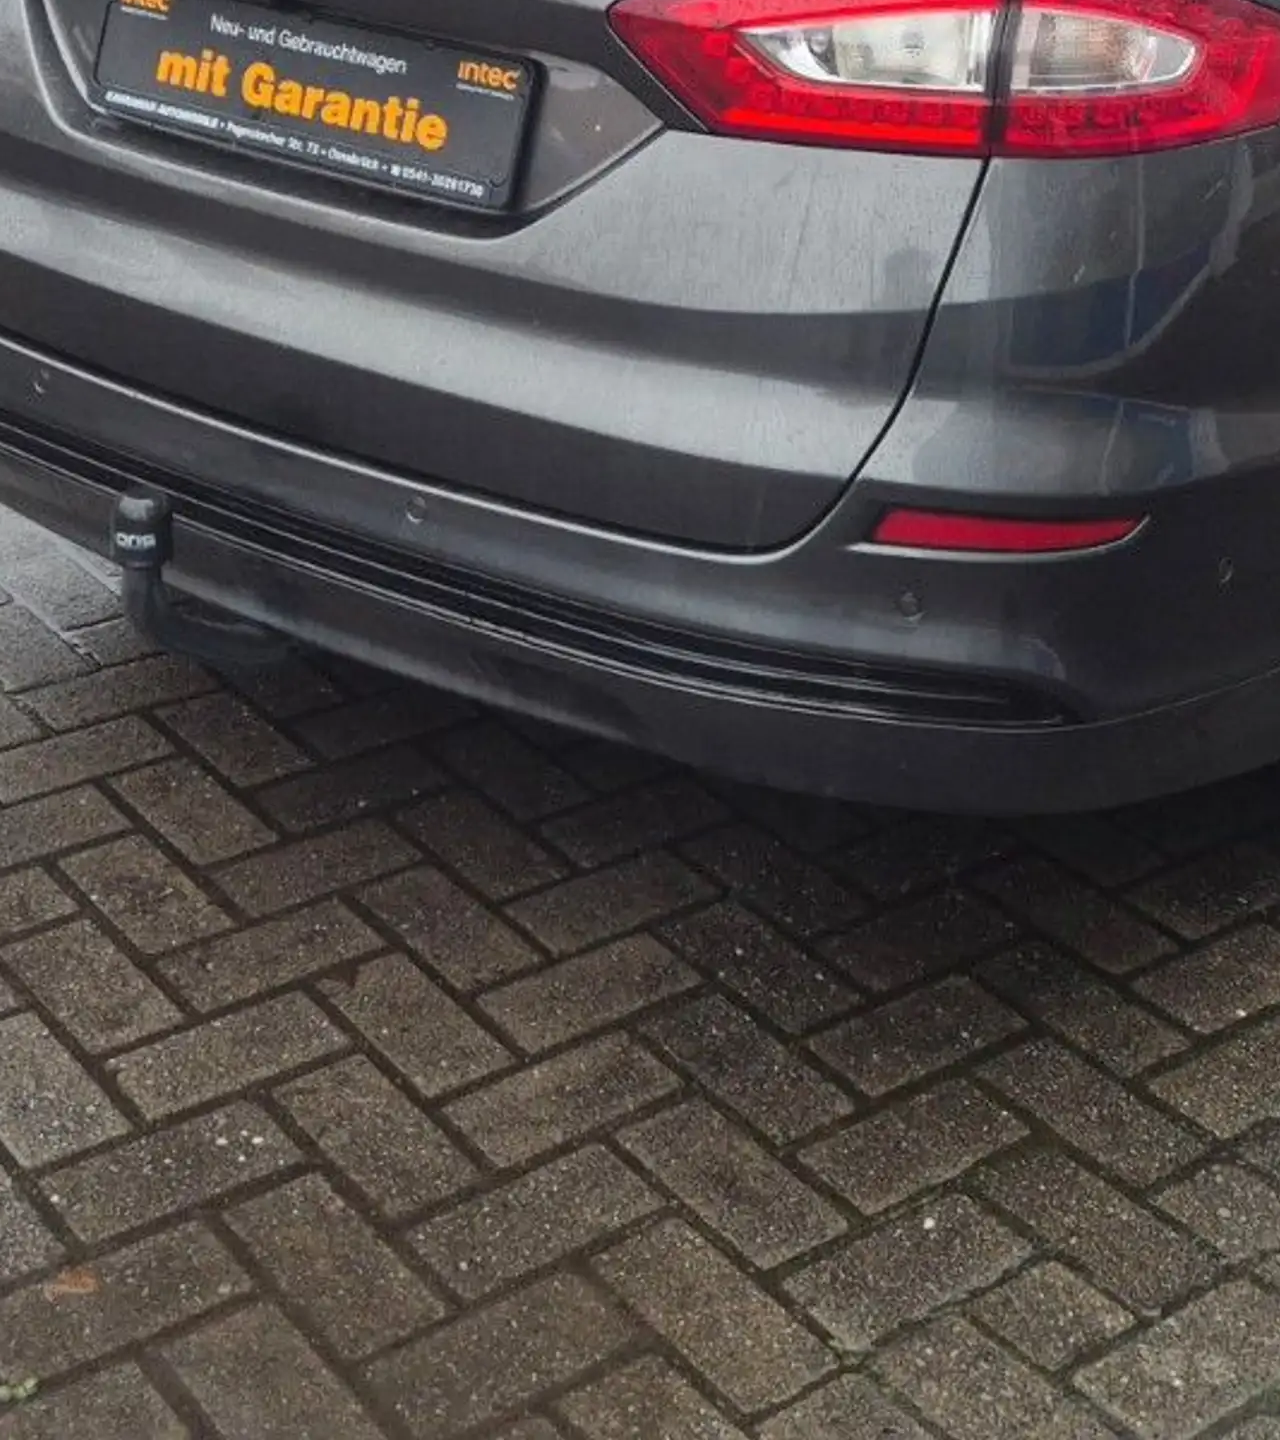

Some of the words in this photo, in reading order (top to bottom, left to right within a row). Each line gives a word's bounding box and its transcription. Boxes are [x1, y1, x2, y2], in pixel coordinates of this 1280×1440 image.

[210, 13, 245, 37] Neu-
[248, 24, 275, 45] und
[278, 28, 408, 75] Gebrauchtwagen
[456, 60, 519, 90] intec
[156, 48, 231, 97] mit
[242, 61, 448, 152] Garantie
